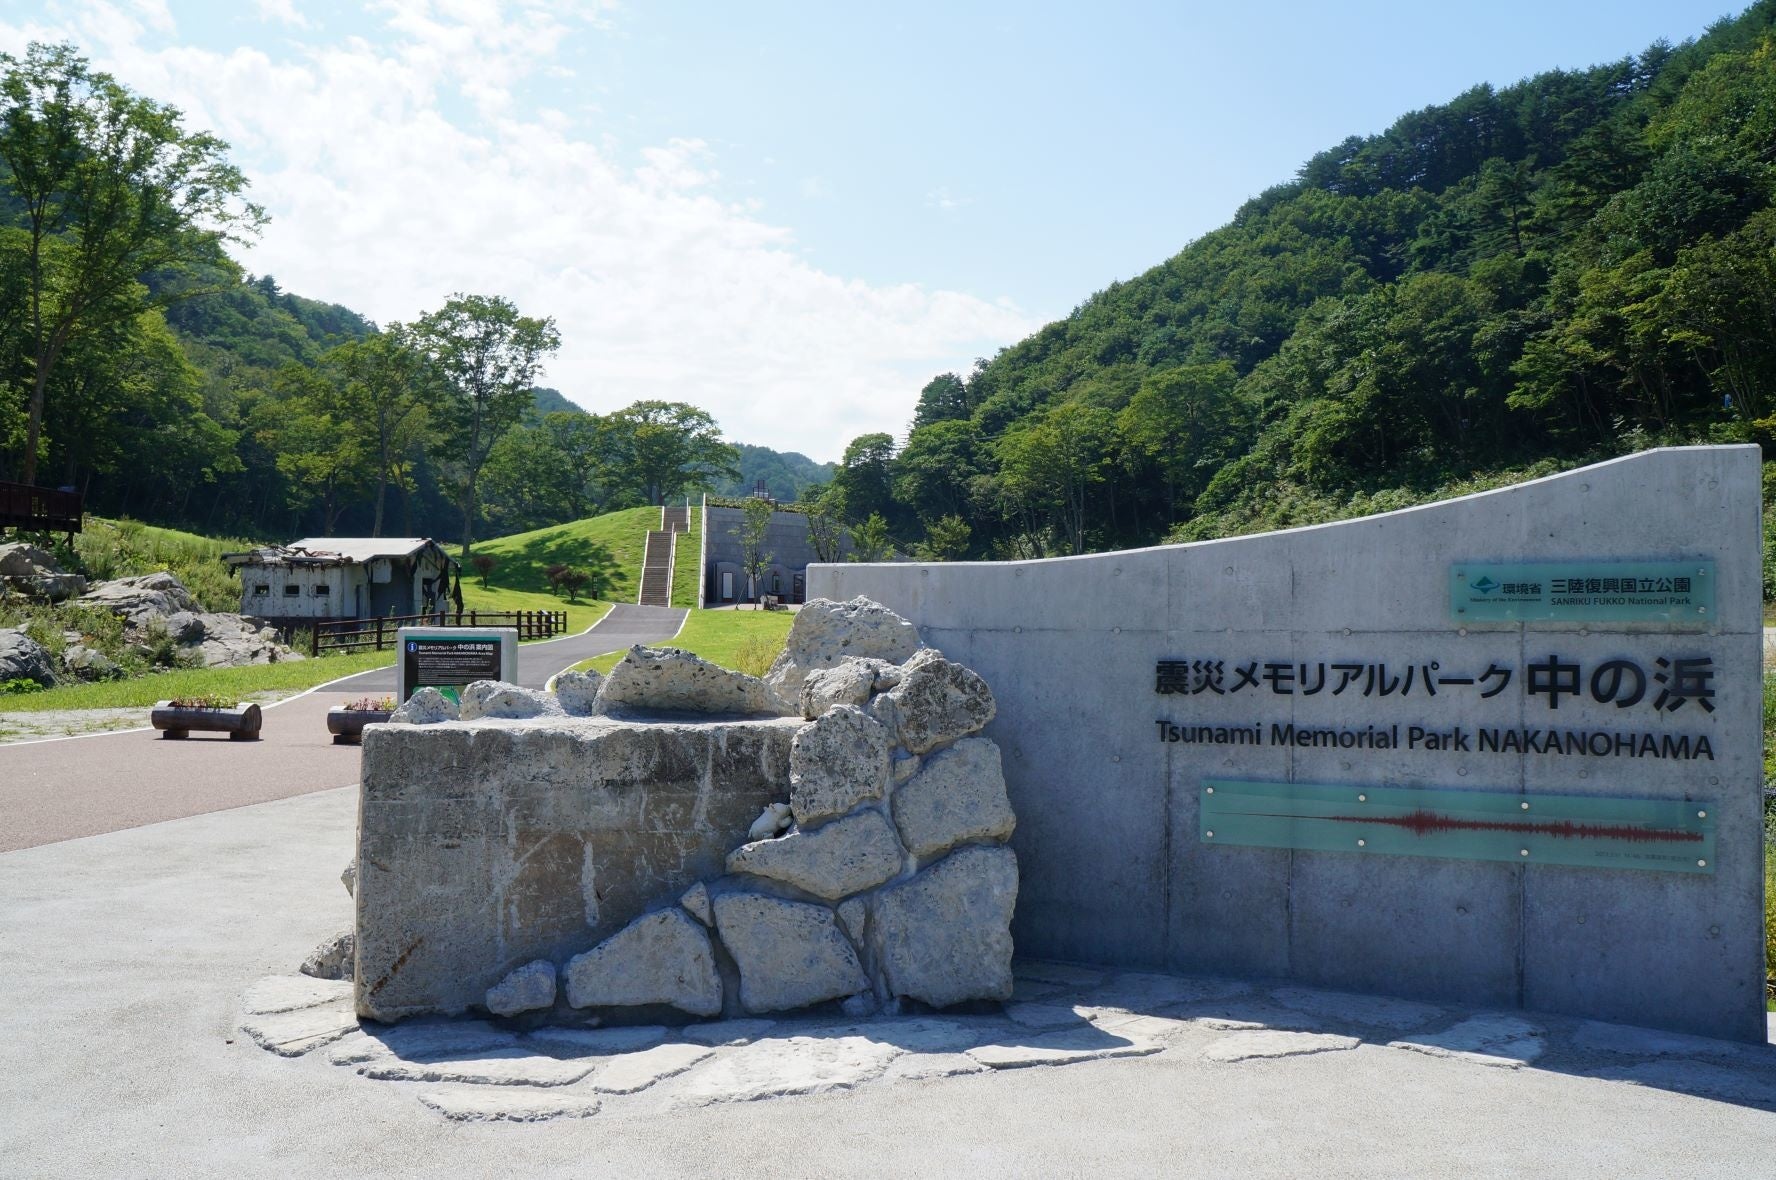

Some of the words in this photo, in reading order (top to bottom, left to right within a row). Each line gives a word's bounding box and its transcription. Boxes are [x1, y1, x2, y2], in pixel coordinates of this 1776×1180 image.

[1502, 583, 1542, 595] 環境省
[1551, 577, 1691, 594] 三陸復興国立公園
[1551, 597, 1590, 605] SANRIKU
[1593, 597, 1625, 605] FUKKO
[1628, 597, 1666, 605] National
[1669, 597, 1691, 605] Park
[1155, 660, 1512, 698] 震災メモリアルパーク
[1528, 655, 1715, 713] 中の浜
[1155, 720, 1261, 745] Tsunami
[1271, 723, 1397, 749] Memorial
[1408, 726, 1470, 752] Park
[1478, 728, 1715, 760] NAKANOHAMA
